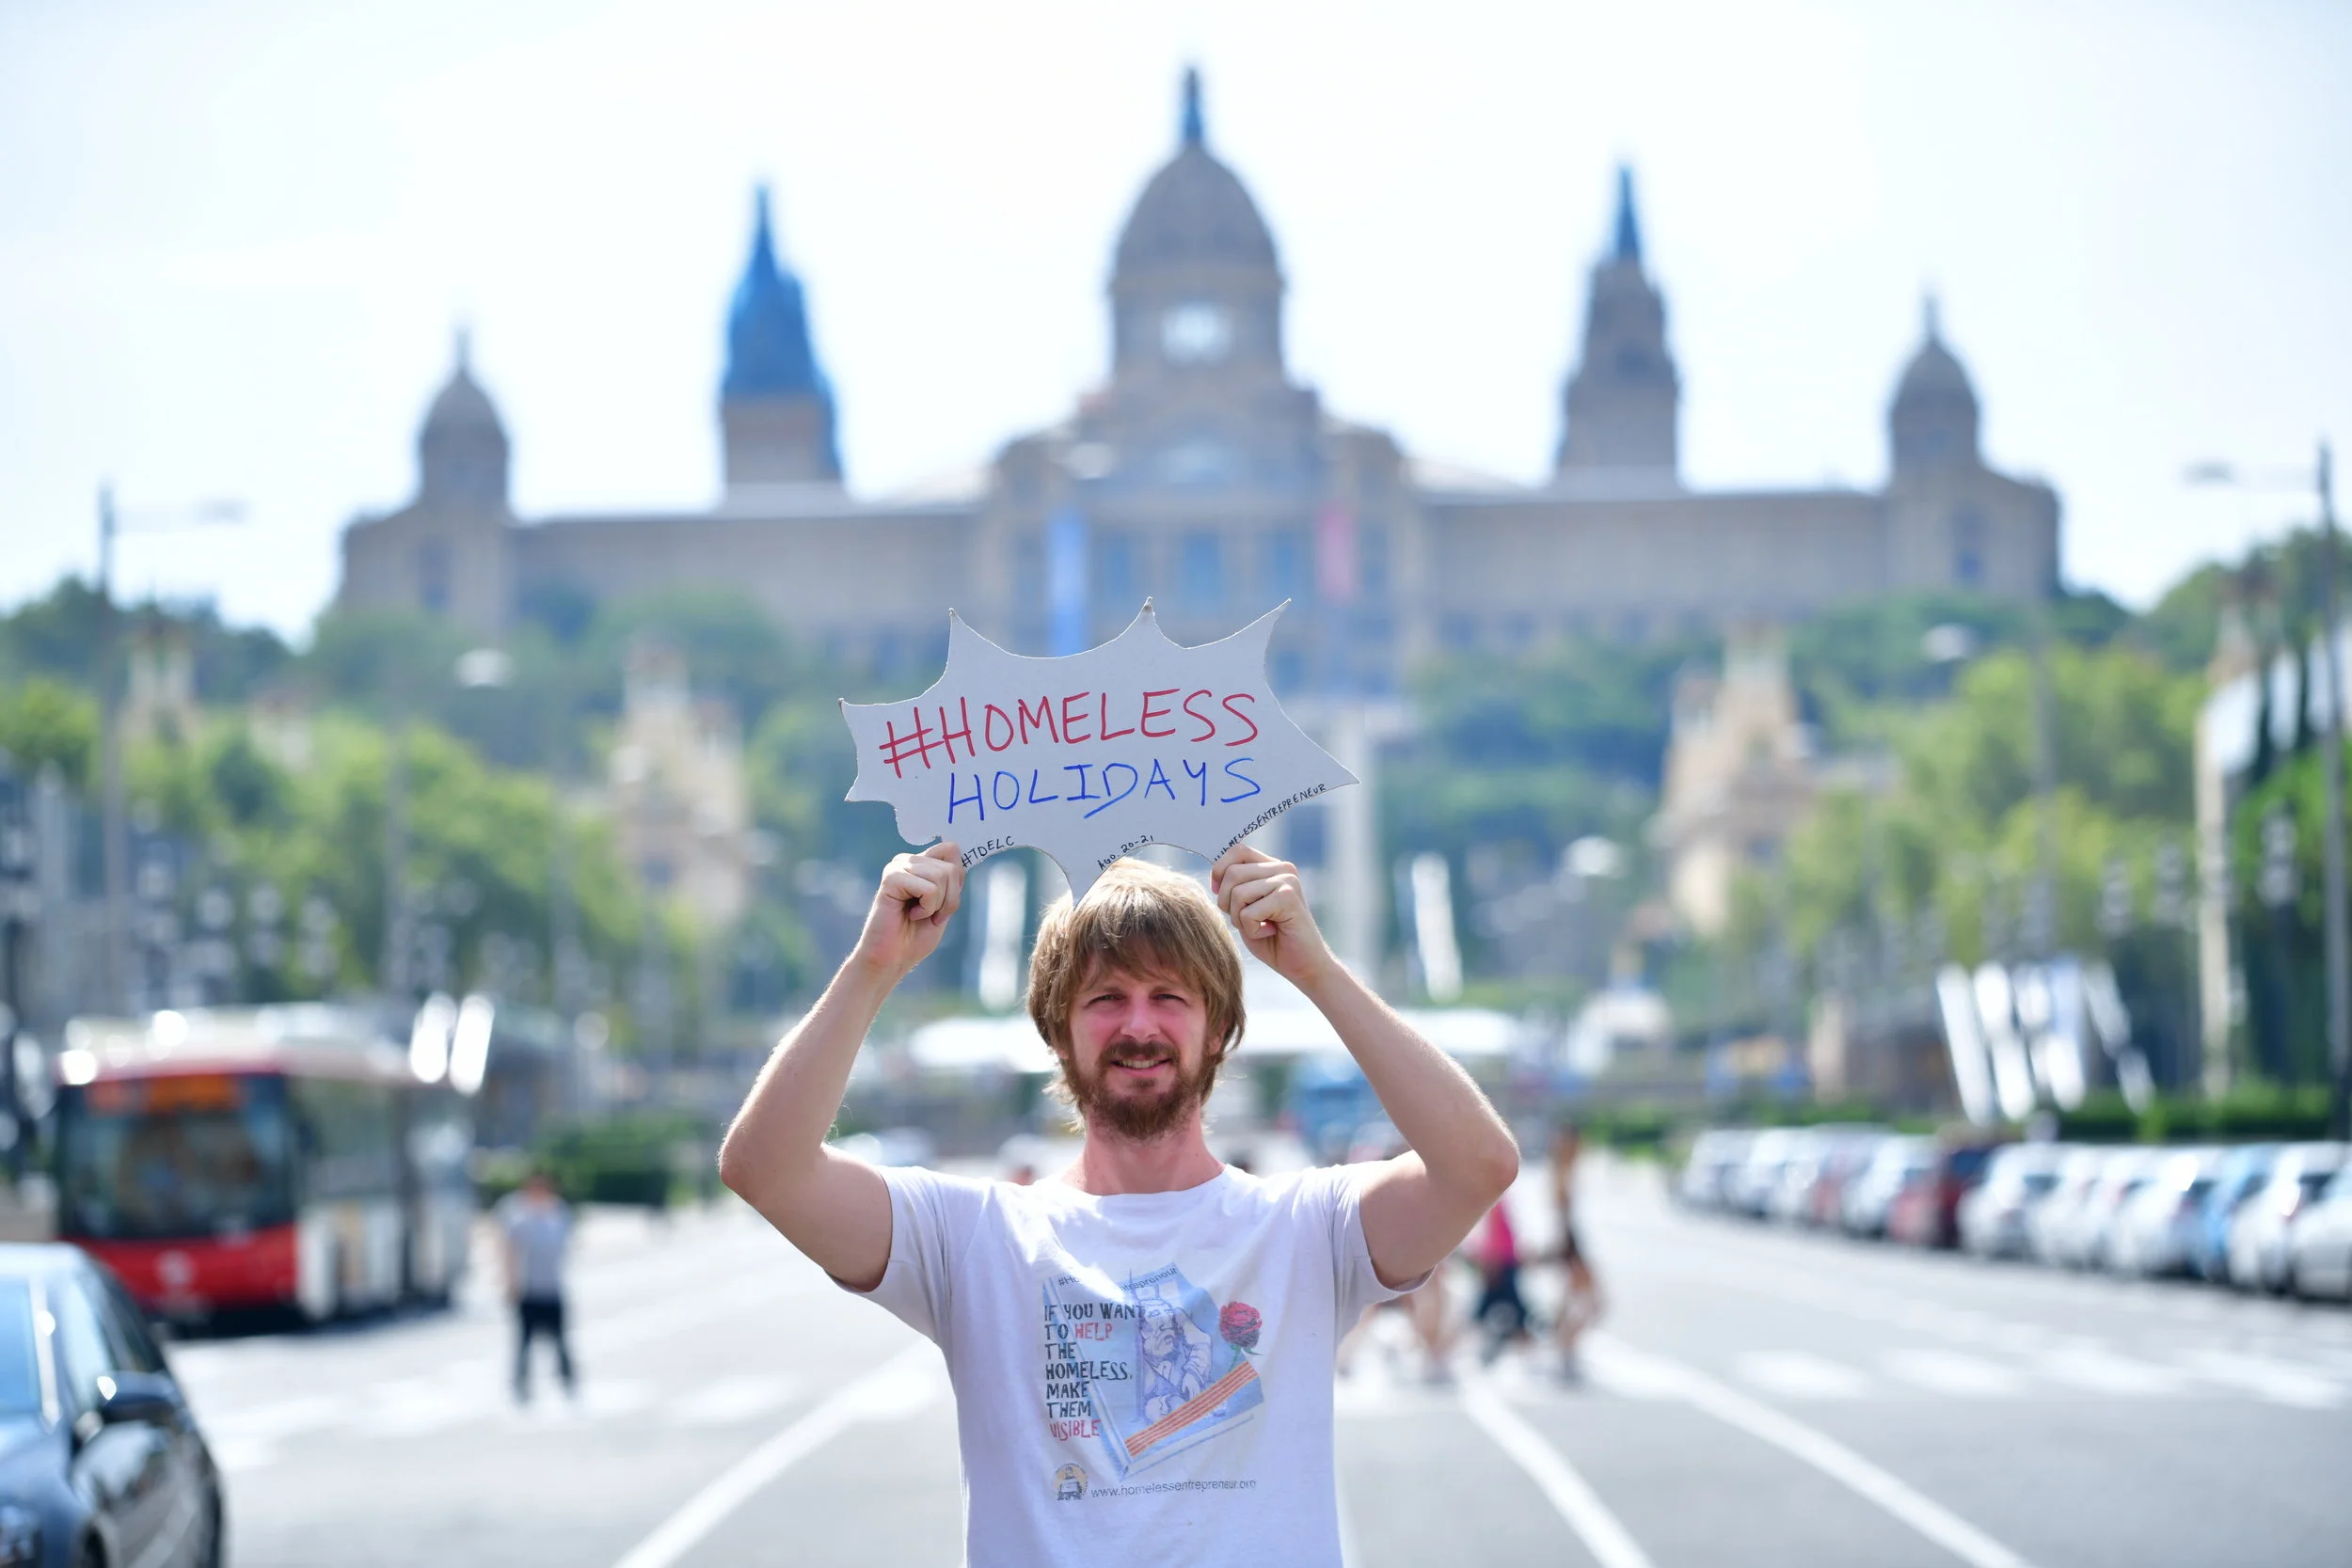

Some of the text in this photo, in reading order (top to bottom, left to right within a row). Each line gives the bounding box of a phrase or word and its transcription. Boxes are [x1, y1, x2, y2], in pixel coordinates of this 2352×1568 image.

[879, 688, 1259, 779] #HOMELESS
[947, 757, 1262, 825] HOLIDAYS
[1214, 783, 1327, 862] MELESSENTREPRENEUR
[961, 835, 1015, 868] #TDELC
[1120, 834, 1154, 854] 20-21
[1044, 1302, 1147, 1322] IF YOU WANT
[1044, 1322, 1113, 1341] TO HELP
[1044, 1341, 1077, 1360] THE
[1046, 1381, 1090, 1400] MAKE
[1046, 1400, 1091, 1418] THEM
[1049, 1418, 1102, 1442] VISIBLE
